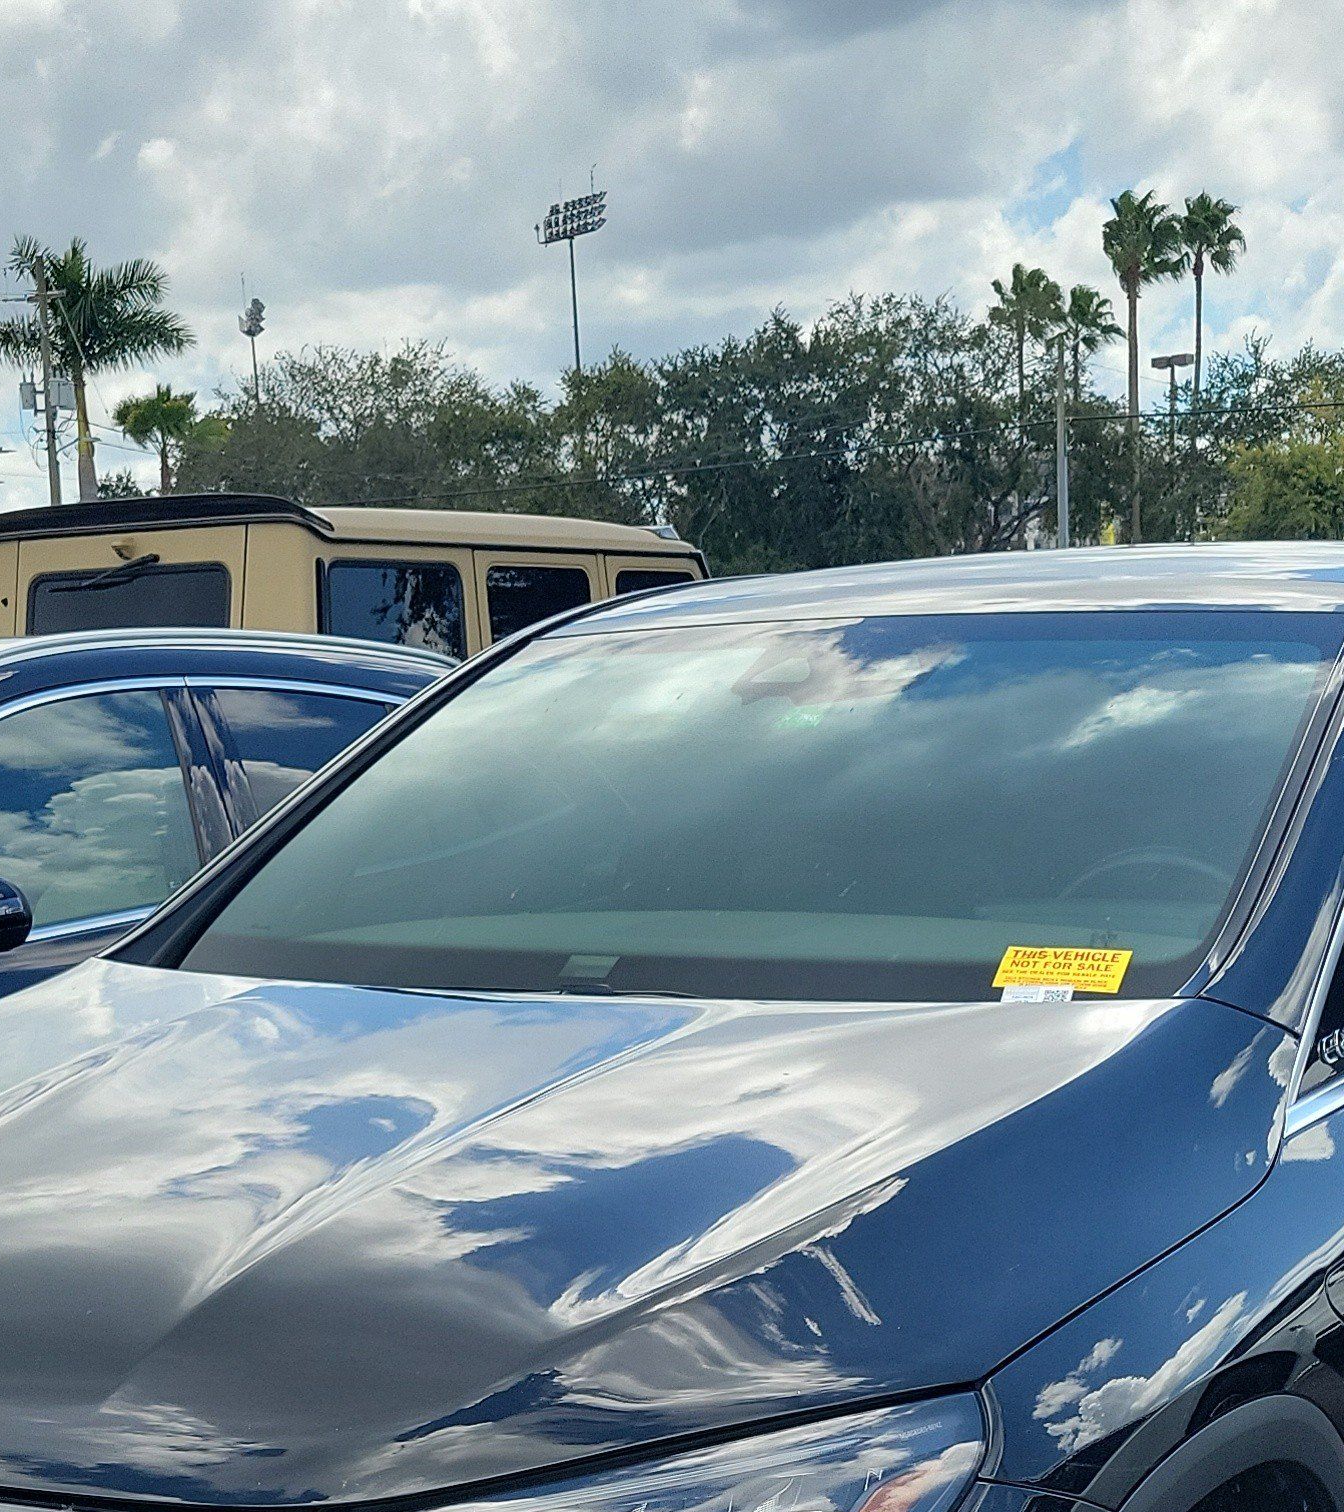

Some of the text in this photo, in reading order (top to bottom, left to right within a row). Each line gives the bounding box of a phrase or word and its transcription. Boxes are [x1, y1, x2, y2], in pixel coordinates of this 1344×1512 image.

[1012, 949, 1122, 963] THIS VEHICLE
[1010, 959, 1114, 972] NOT FOR SALE
